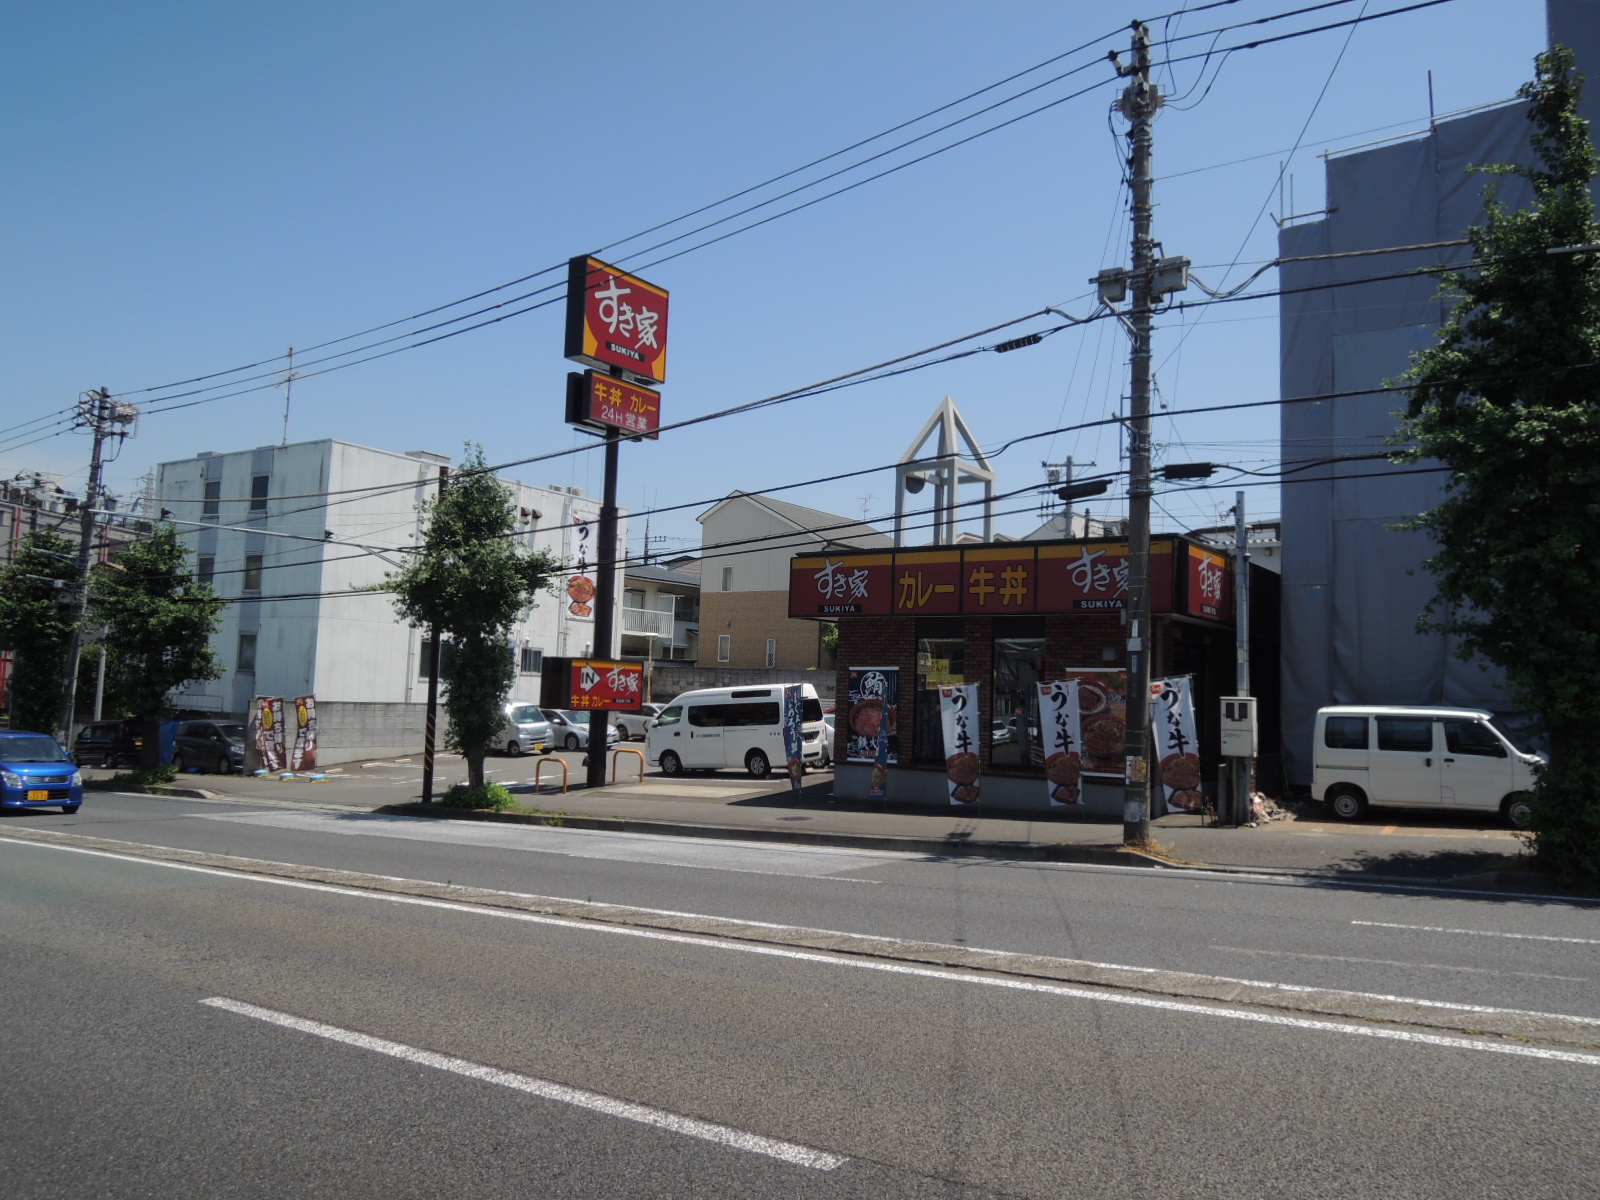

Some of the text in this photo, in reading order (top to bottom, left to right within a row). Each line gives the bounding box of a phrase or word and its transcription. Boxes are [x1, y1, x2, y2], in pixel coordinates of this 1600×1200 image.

[594, 274, 659, 349] すき家
[610, 343, 640, 360] SUKIYA
[594, 382, 657, 414] 牛丼 カレー
[813, 558, 869, 604] すき家
[898, 564, 1028, 609] カレー 牛丼
[1198, 551, 1222, 605] すき家
[823, 605, 855, 613] SUKIYA
[1080, 600, 1123, 608] SUKIYA
[581, 672, 595, 684] IN
[606, 664, 639, 696] すき家
[571, 694, 611, 708] 牛丼 カレー
[1050, 684, 1075, 755] うな牛
[1160, 682, 1190, 757] うな牛
[951, 687, 973, 756] うな牛
